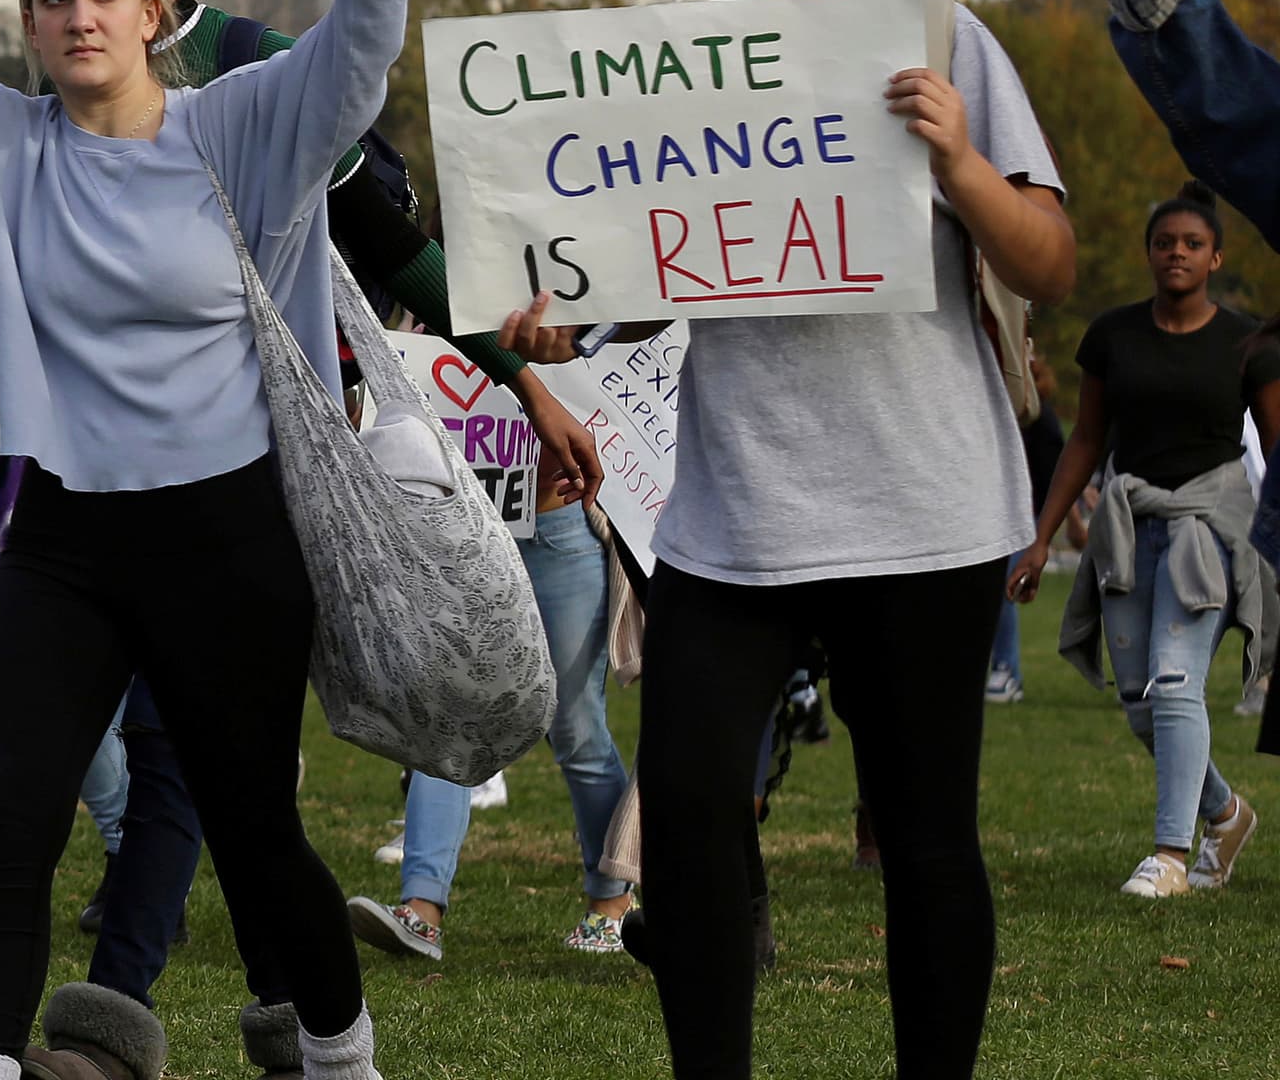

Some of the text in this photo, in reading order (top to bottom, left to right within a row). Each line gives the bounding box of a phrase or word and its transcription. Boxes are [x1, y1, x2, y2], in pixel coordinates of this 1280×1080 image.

[459, 32, 783, 116] CLIMATE
[546, 114, 855, 198] CHANGE
[524, 195, 884, 302] IS REAL
[601, 371, 677, 454] EXPECT
